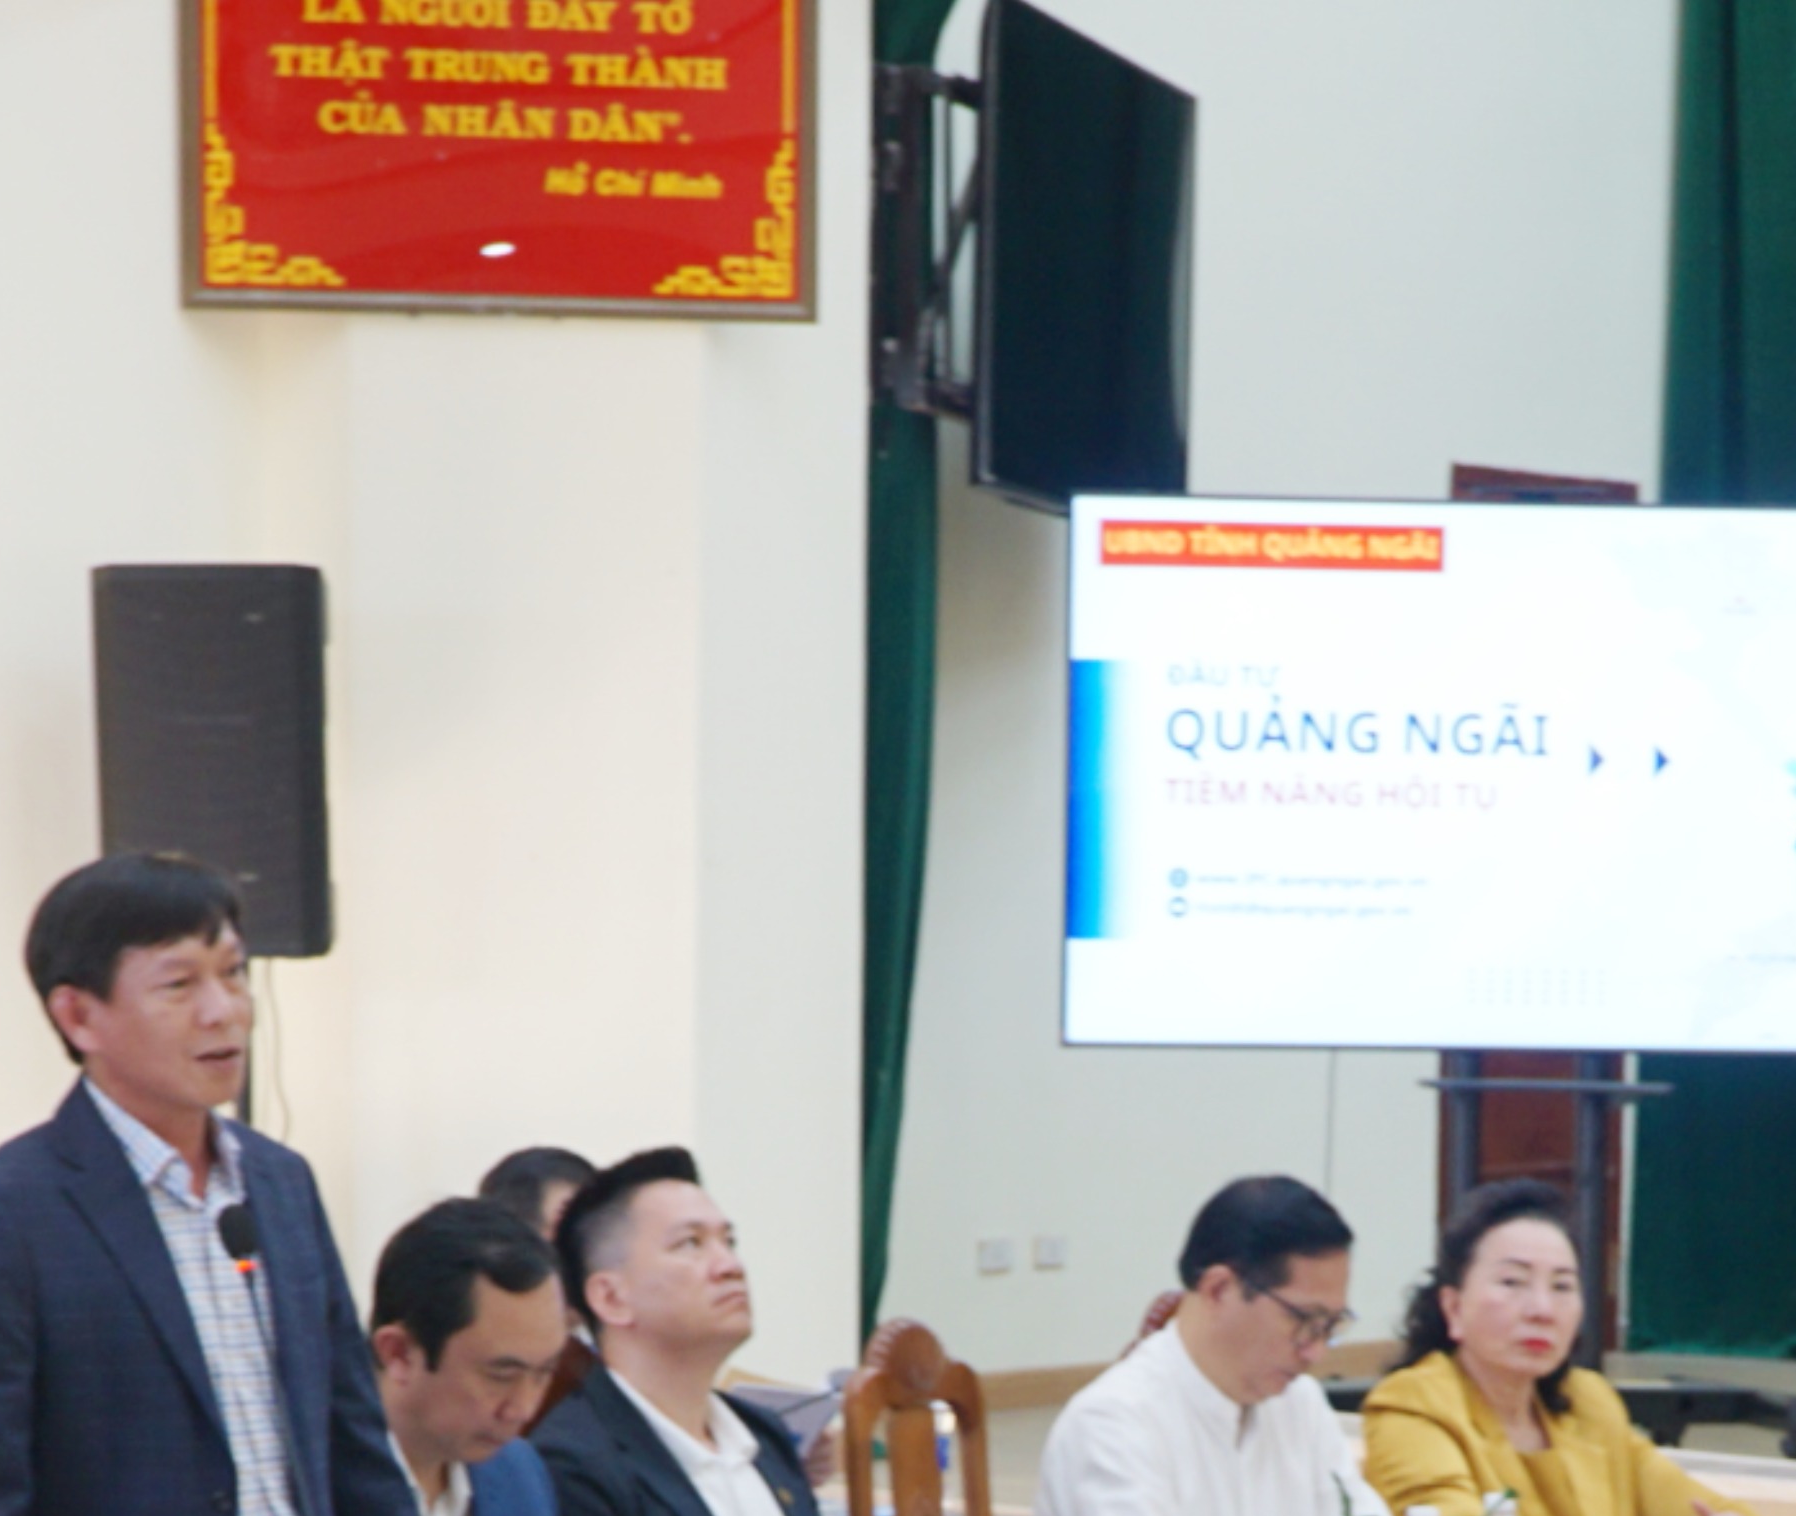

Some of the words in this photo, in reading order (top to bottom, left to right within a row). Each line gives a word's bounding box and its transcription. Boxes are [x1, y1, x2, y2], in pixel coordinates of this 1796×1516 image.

[269, 39, 389, 86] THẬT
[405, 47, 550, 84] TRUNG
[566, 46, 727, 90] THÀNH
[318, 90, 407, 135] CỦA
[423, 100, 555, 139] NHÂN
[1104, 529, 1184, 555] UBND
[1261, 527, 1364, 562] QUẢNG
[1166, 694, 1380, 761] QUẢNG
[1405, 703, 1549, 756] NGÃI
